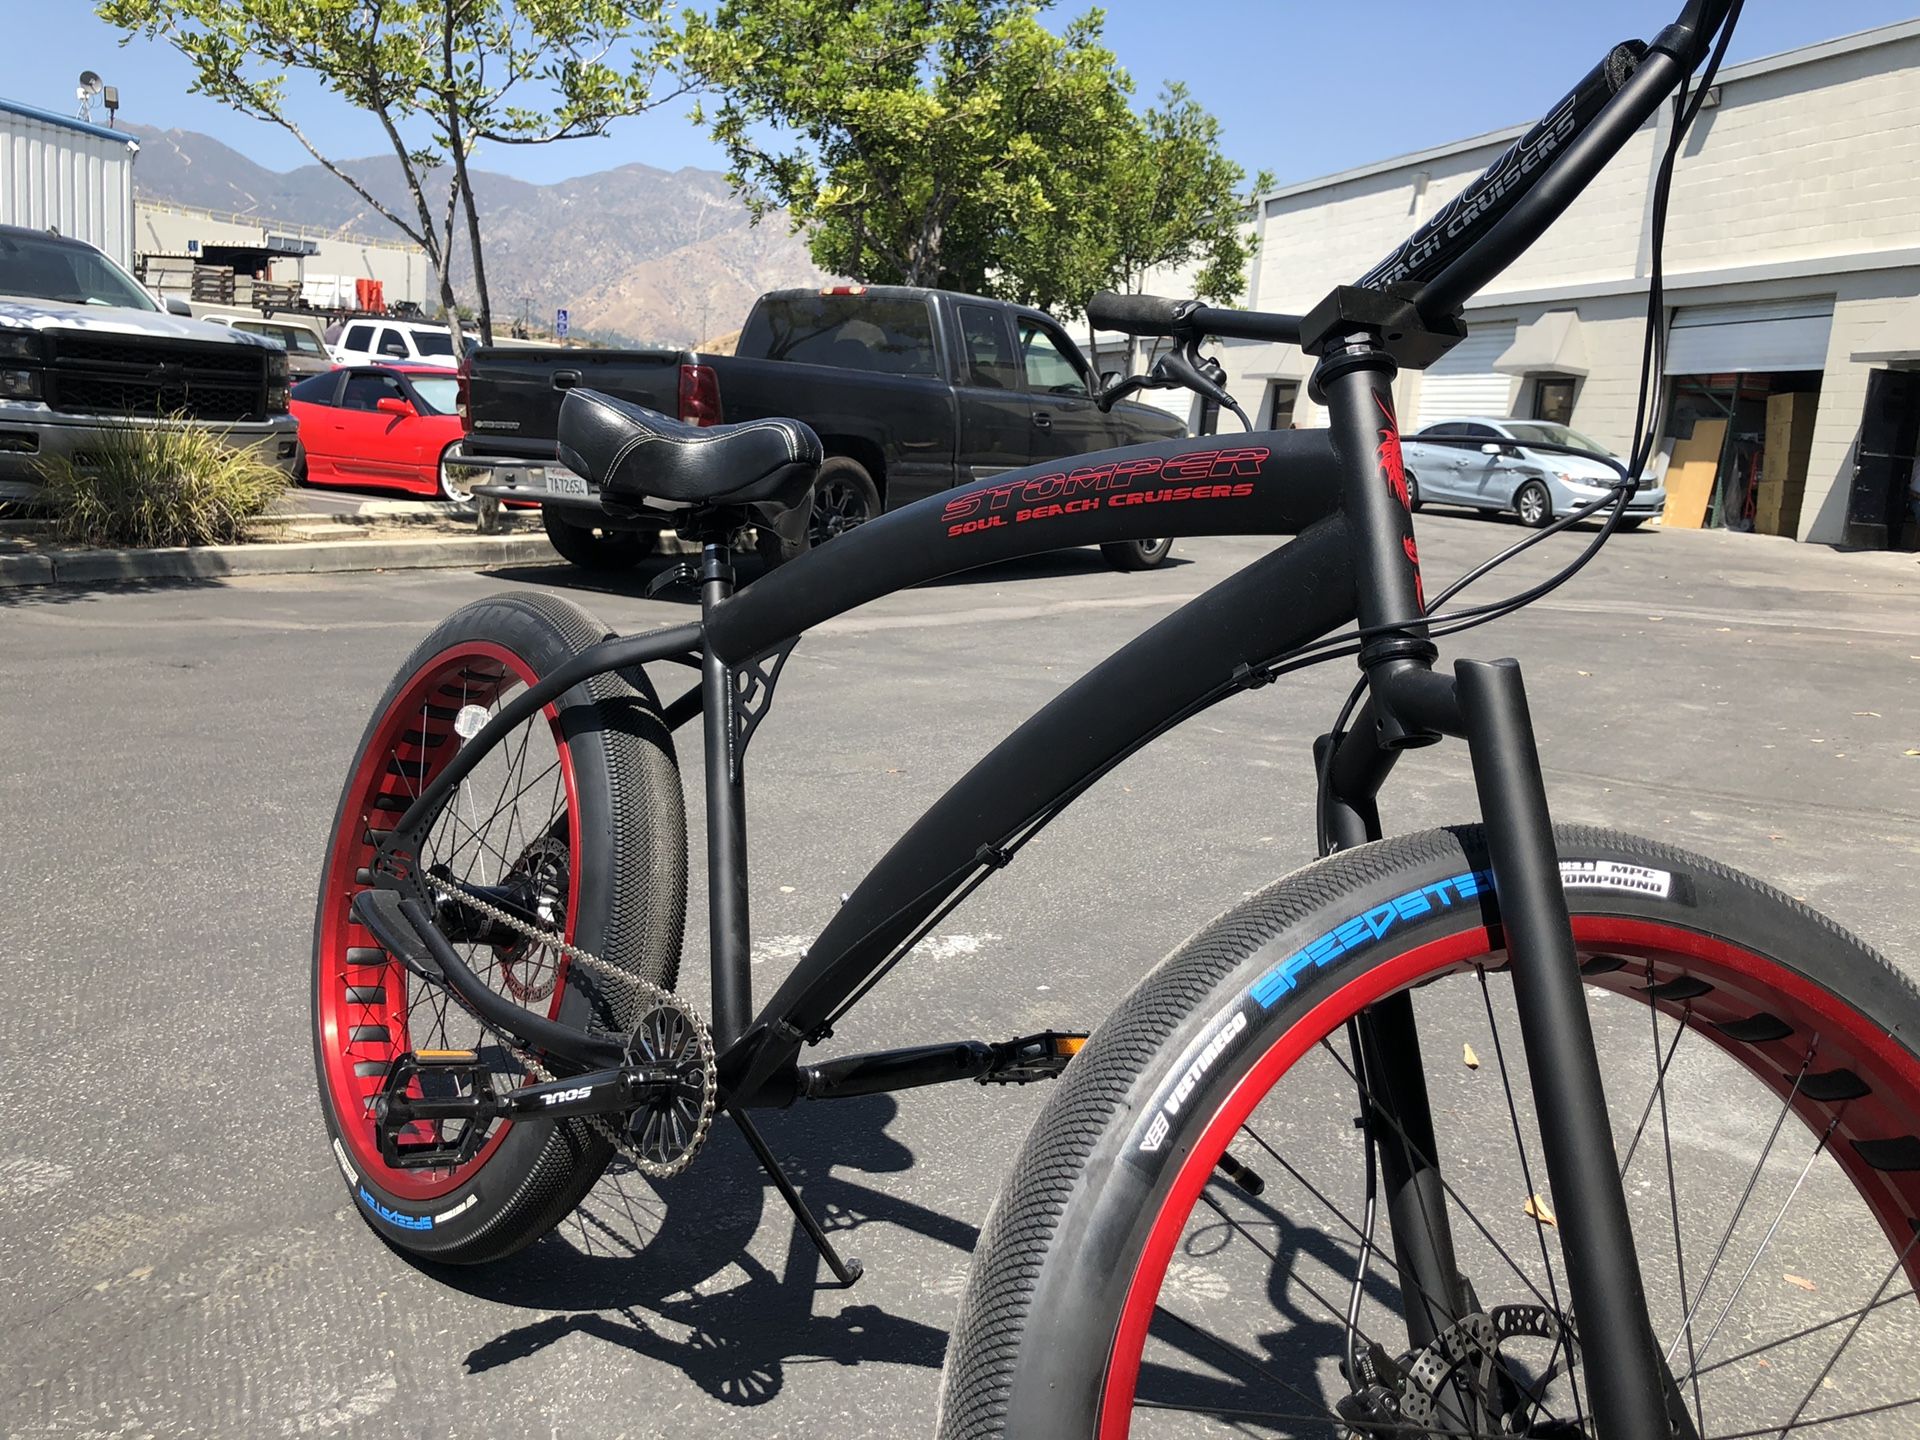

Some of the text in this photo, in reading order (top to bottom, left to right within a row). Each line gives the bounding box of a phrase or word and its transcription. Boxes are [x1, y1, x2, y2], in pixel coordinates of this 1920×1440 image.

[1447, 118, 1576, 238] CRUISERS
[548, 477, 585, 494] 7A72654
[941, 447, 1271, 522] STOMPER
[948, 483, 1255, 537] SOUL BEACH CRUISERS
[1610, 864, 1655, 879] MPC
[1560, 874, 1663, 892] OMPOUND
[540, 1086, 593, 1105] SOUL
